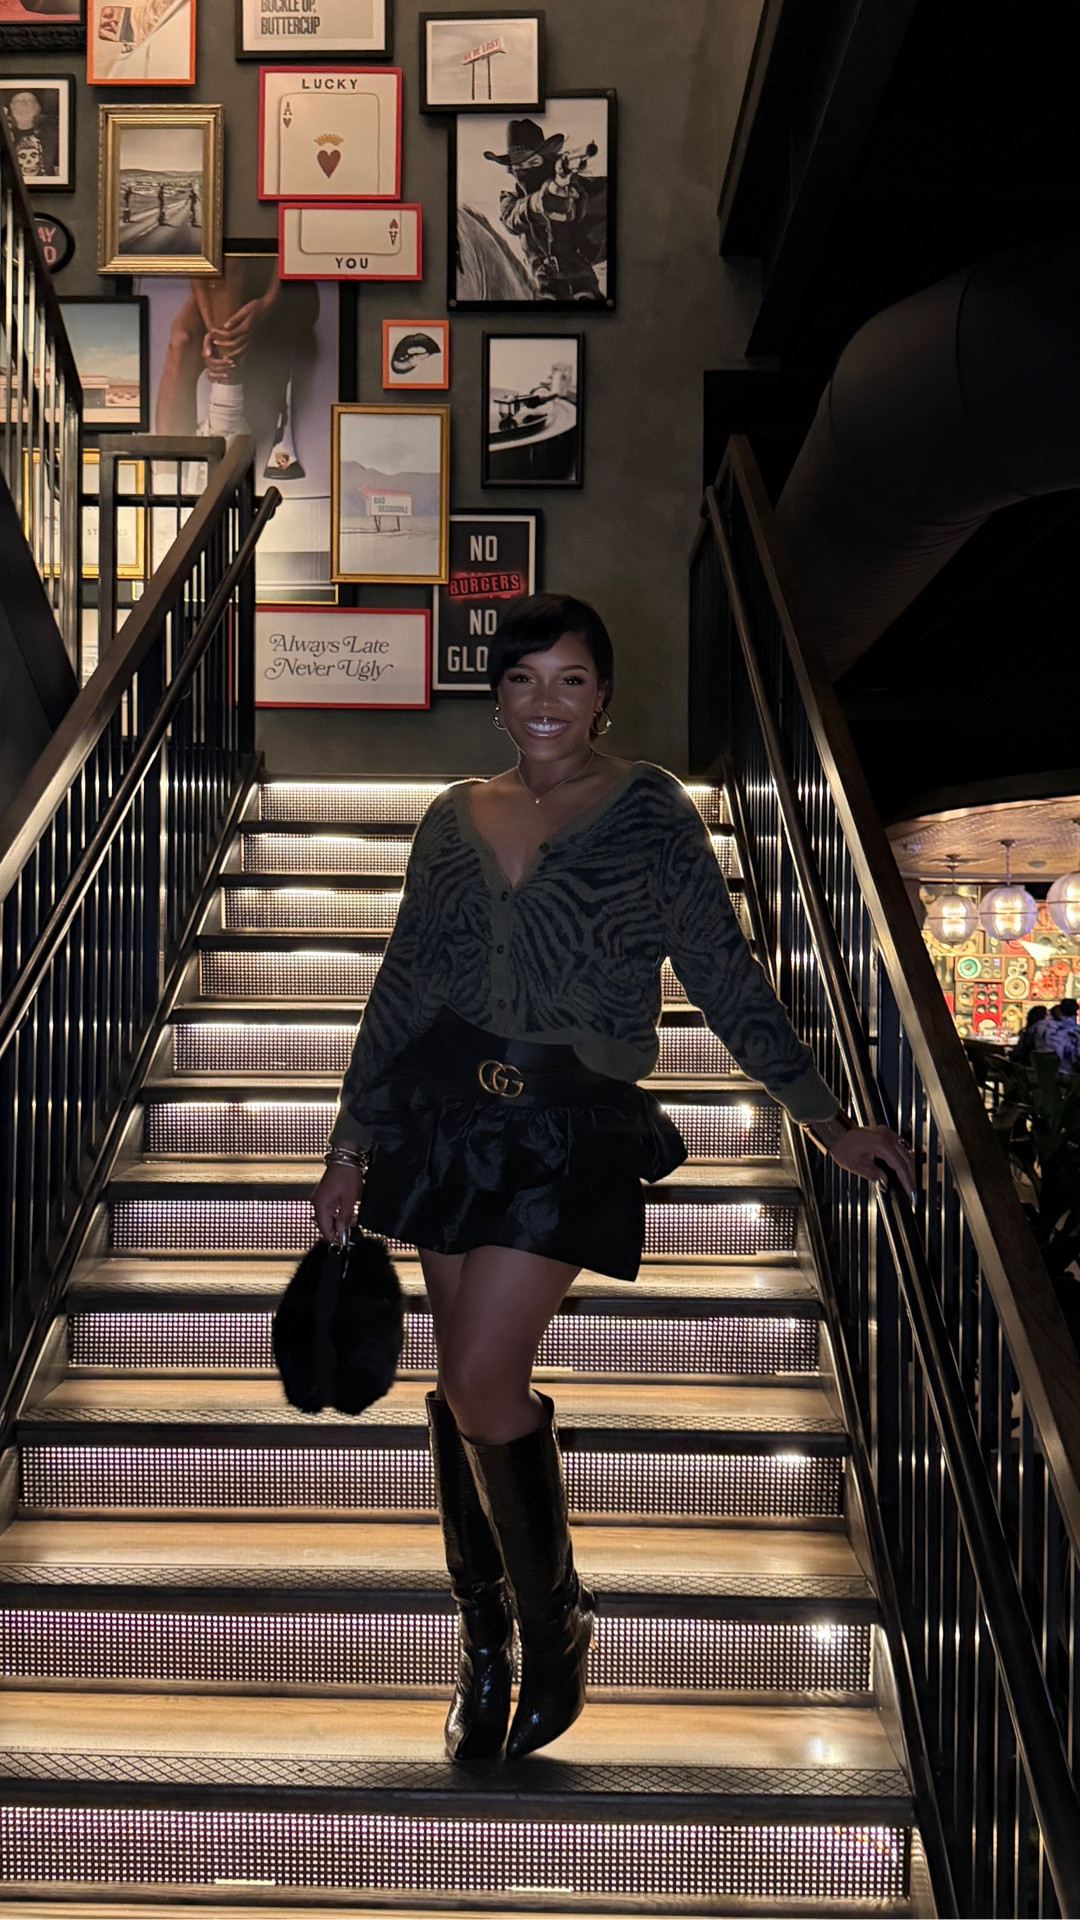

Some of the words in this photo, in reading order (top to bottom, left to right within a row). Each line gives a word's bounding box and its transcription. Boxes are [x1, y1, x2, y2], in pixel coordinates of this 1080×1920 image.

[261, 0, 301, 12] BUCKLE
[261, 17, 320, 35] BUTTERCUP
[302, 79, 358, 89] LUCKY
[283, 102, 293, 116] A
[335, 257, 369, 269] YOU
[470, 535, 498, 562] NO
[450, 573, 520, 596] BURGERS
[469, 609, 497, 635] NO
[269, 633, 340, 658] Always
[342, 635, 390, 653] Late
[264, 657, 336, 681] Never
[337, 659, 395, 682] Ugly
[447, 646, 488, 672] GLO
